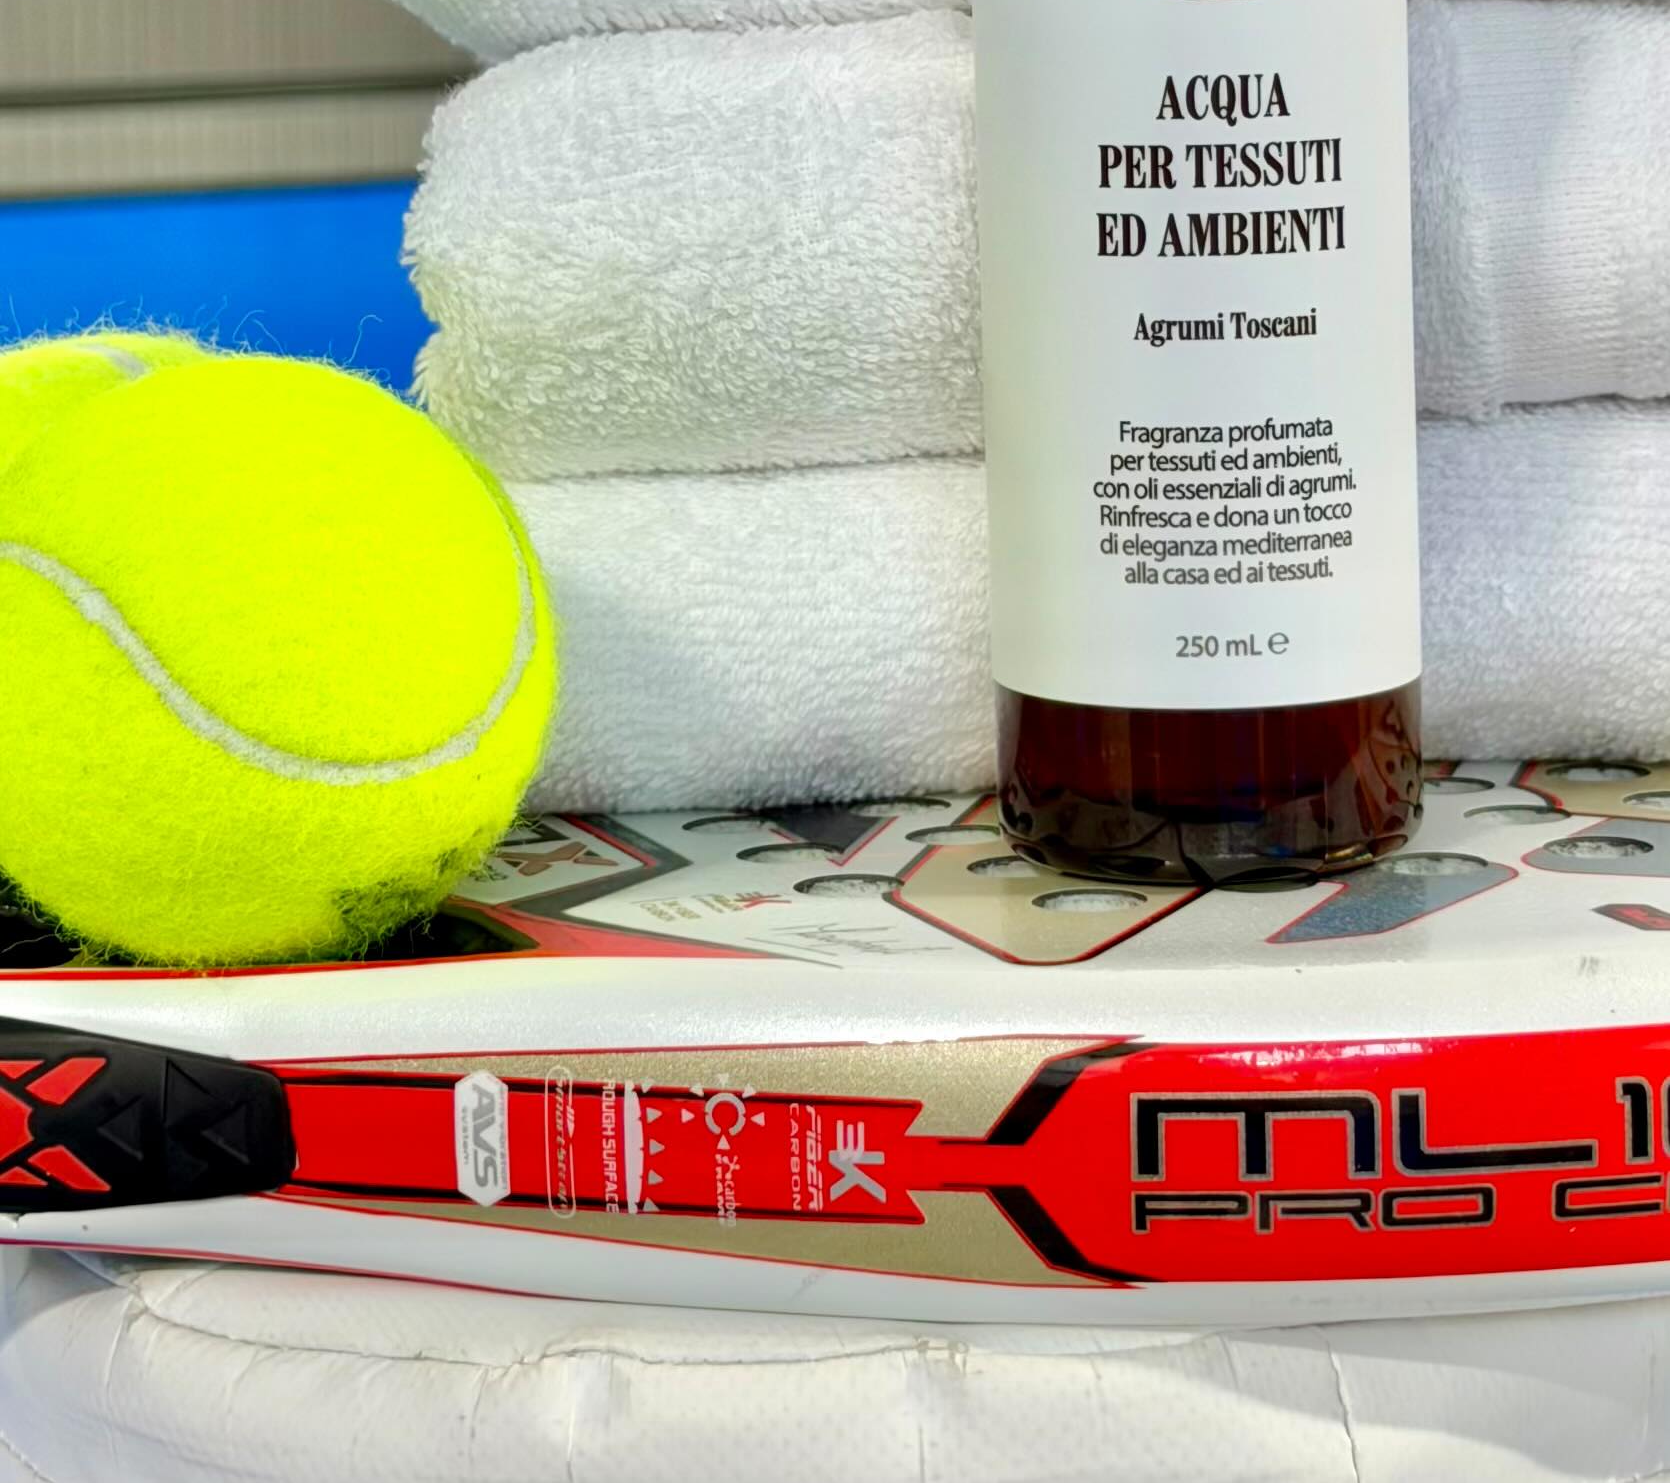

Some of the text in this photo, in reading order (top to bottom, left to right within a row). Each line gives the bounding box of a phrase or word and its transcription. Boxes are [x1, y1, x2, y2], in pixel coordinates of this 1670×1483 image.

[1155, 72, 1292, 128] ACQUA
[1097, 137, 1343, 190] PER TESSUTI
[1095, 204, 1346, 258] ED AMBIENTI
[1133, 307, 1318, 348] Agrumi Toscani
[1110, 441, 1343, 477] per tessuti ed ambienti,
[1119, 416, 1334, 450] Fragranza profumata
[1092, 467, 1357, 501] con oli essenziali di agrumi.
[1099, 501, 1353, 529] Rinfresca e dona un tocco
[1099, 529, 1353, 563] di eleganza mediterranea
[1124, 555, 1334, 586] alla casa ed ai tessuti.
[1175, 635, 1220, 658] 250
[1225, 633, 1263, 657] mL
[471, 1083, 499, 1188] AVS
[601, 1079, 619, 1213] ROUGH SURFACE
[1615, 1075, 1670, 1164] 1
[789, 1102, 801, 1211] CARBON
[805, 1104, 823, 1212] FIBER
[1131, 1172, 1670, 1234] PRO C
